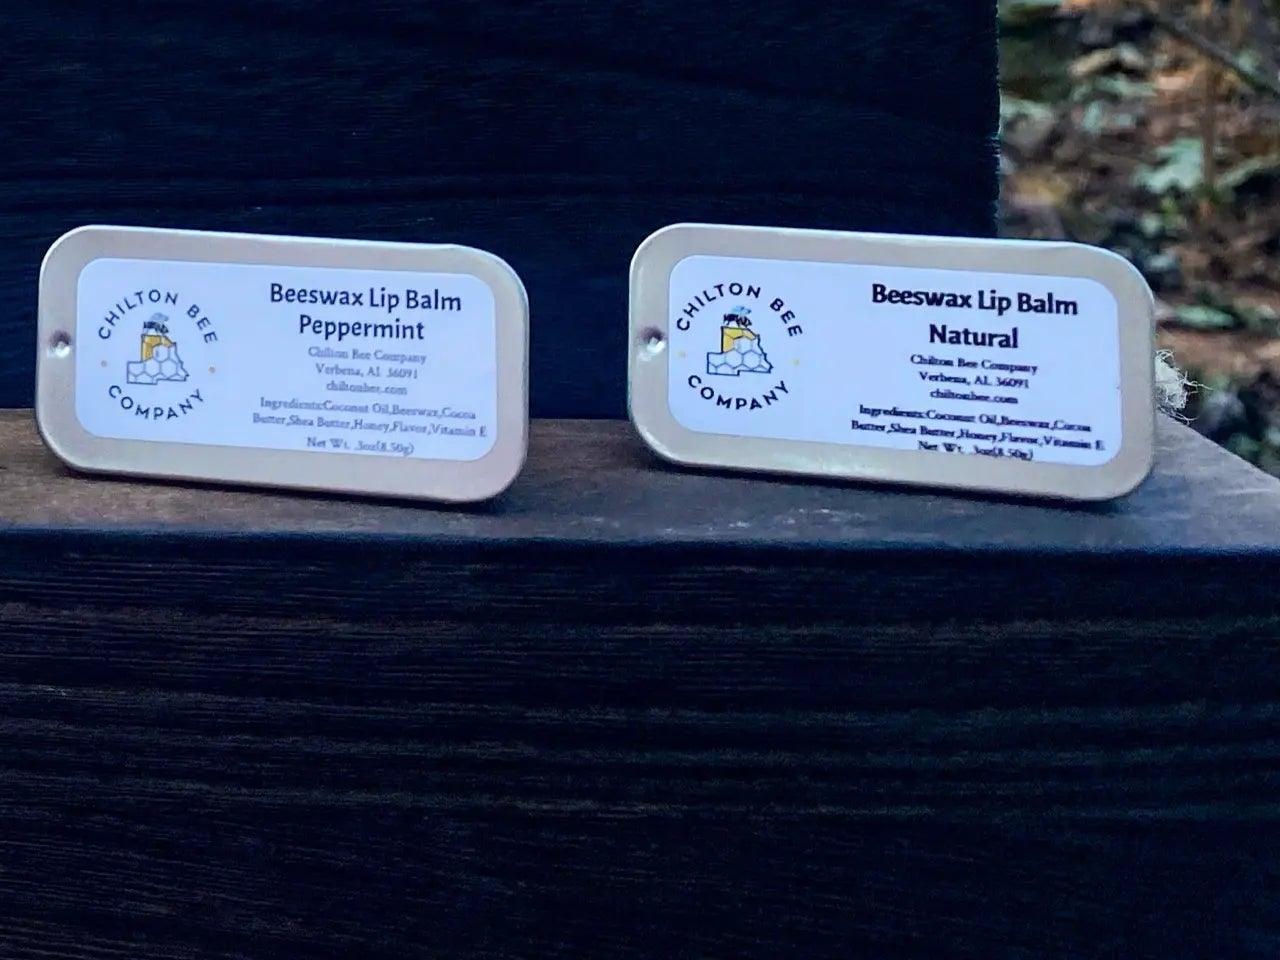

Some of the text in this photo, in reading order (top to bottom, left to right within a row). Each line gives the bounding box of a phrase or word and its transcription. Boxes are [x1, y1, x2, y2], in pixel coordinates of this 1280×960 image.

[270, 283, 462, 313] Beeswax Lip Balm
[677, 283, 802, 338] CHILTON BEE
[872, 284, 1078, 316] Beeswax Lip Balm
[99, 289, 217, 343] CHILTON BEE
[299, 314, 424, 341] Peppermint
[929, 324, 1019, 349] Natural
[109, 385, 204, 420] COMPANY
[688, 375, 790, 410] COMPANY
